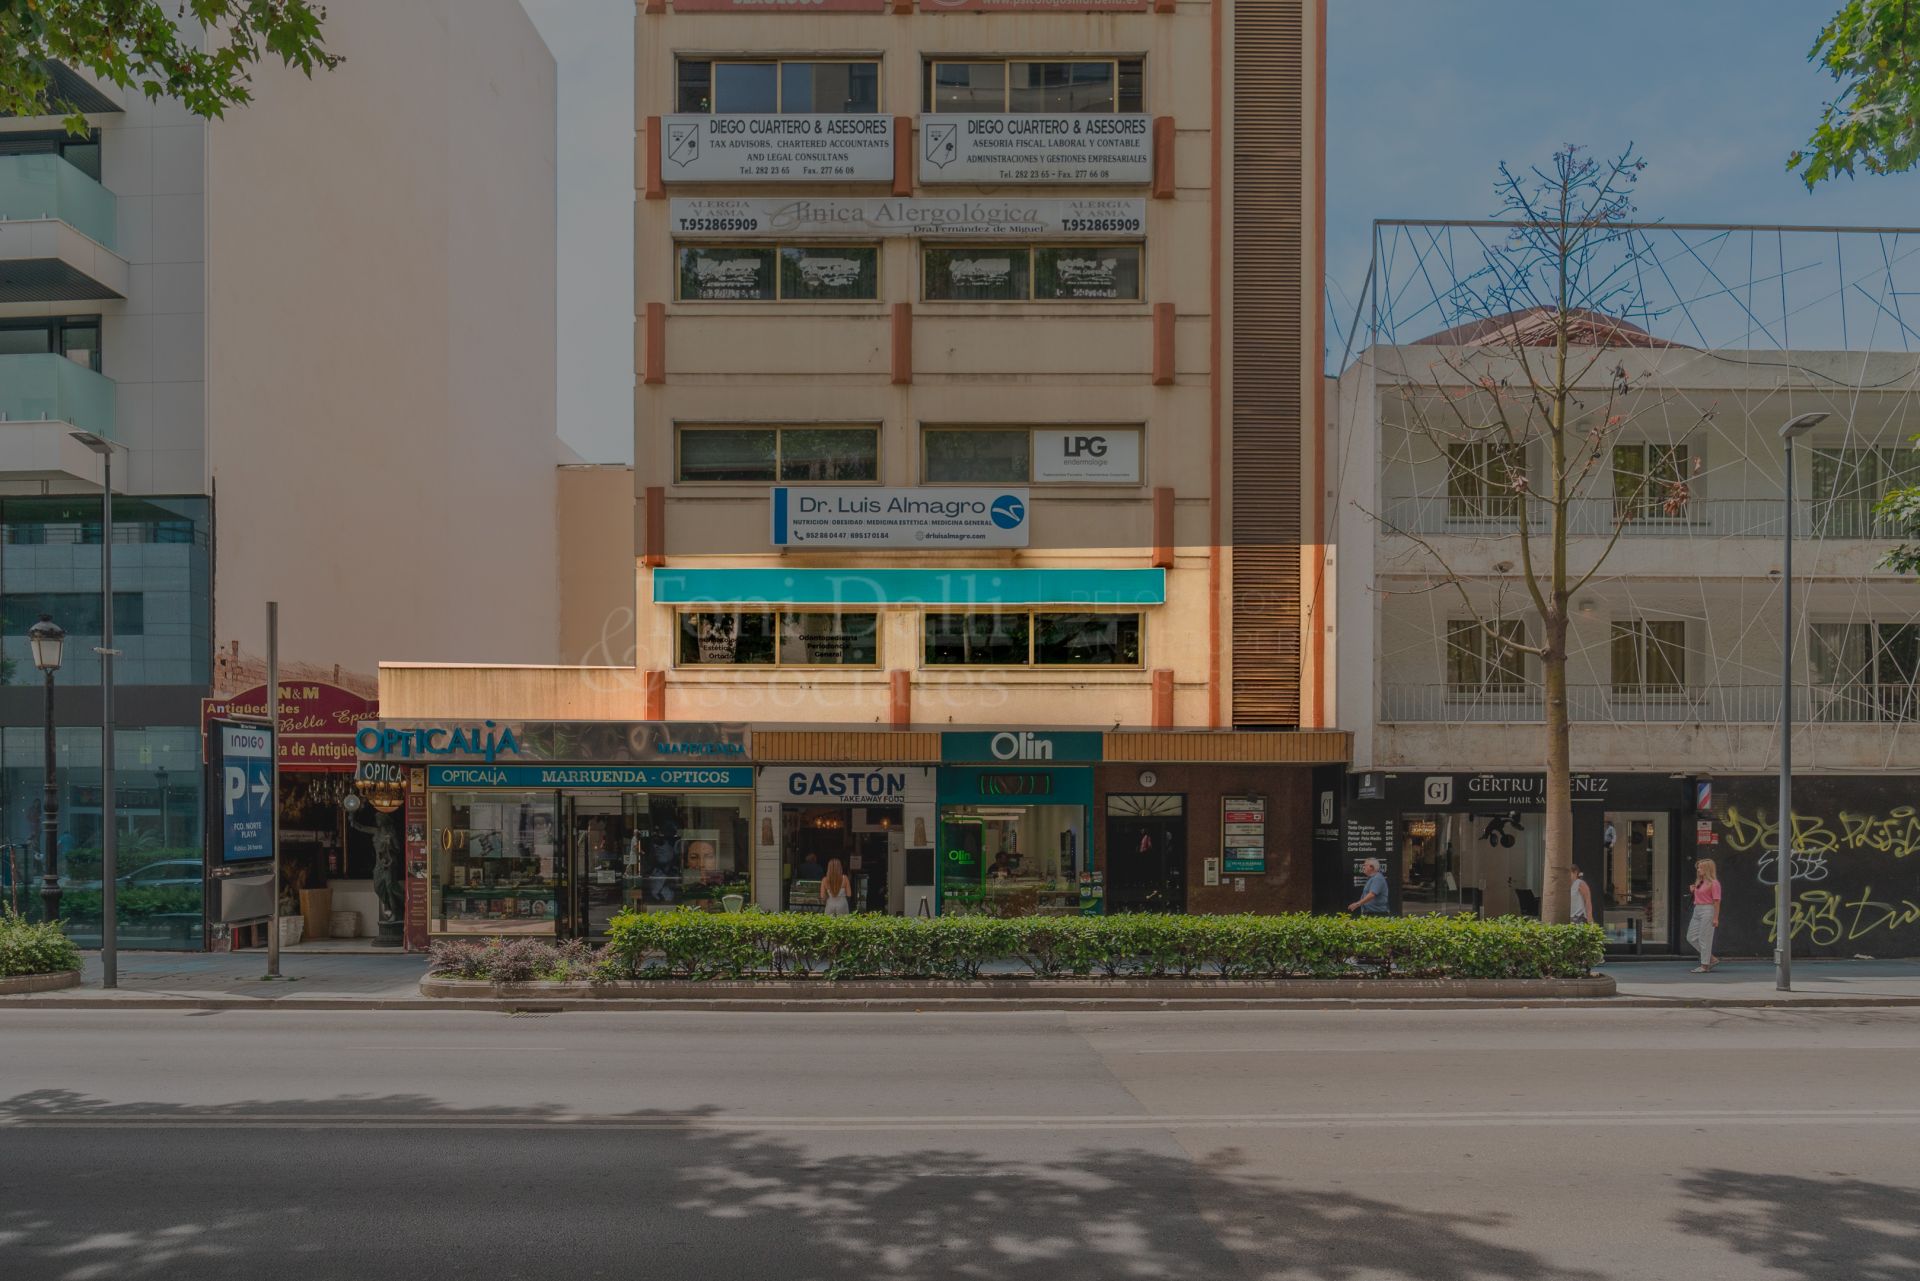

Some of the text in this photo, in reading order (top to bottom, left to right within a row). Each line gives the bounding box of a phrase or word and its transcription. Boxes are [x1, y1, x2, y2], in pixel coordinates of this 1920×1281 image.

[710, 119, 887, 134] DIEGO CUARTERO & ASESORES
[968, 119, 1146, 134] DIEGO CUARTERO & ASESORES
[710, 140, 889, 149] TAX ADVISORS, CHARTERED ACCOUNTANTS
[973, 139, 1013, 148] ASESORIA
[1048, 139, 1086, 148] LABORAL
[1089, 139, 1096, 147] Y
[1097, 139, 1140, 148] CONTABLE
[747, 153, 849, 161] AND LEGAL CONSULTANS
[966, 155, 1147, 163] ADMINISTRACIONES Y GESTIONES EMPRESARIALES
[740, 166, 854, 175] Tel. 282 23 65 Fax. 277 66 08
[1000, 170, 1013, 178] Tel.
[1015, 170, 1028, 178] 282
[1030, 170, 1040, 178] 23
[1041, 170, 1050, 178] 65
[1057, 170, 1073, 178] Fax.
[1075, 170, 1088, 178] 277
[1090, 170, 1099, 178] 66
[1100, 170, 1109, 178] 08
[1069, 201, 1131, 209] ALERGIA
[875, 202, 1038, 226] Alergológica
[1074, 210, 1126, 218] Y ASMA
[680, 218, 758, 231] T.952865909
[993, 225, 1007, 233] de
[1009, 225, 1044, 234] Miguel
[1062, 218, 1140, 231] T.952865909
[1063, 436, 1108, 457] LPG
[800, 496, 986, 517] Dr. Luis Almagro
[278, 687, 319, 700] N&M
[206, 703, 300, 715] Antigüeddes
[278, 714, 327, 732] Bella
[231, 734, 264, 751] INDIGO
[291, 742, 305, 756] de
[655, 742, 745, 755] MARRUENDA
[991, 732, 1053, 760] Olin
[542, 770, 648, 783] MARRUENDA
[660, 770, 730, 784] OPTICOS
[788, 767, 905, 796] GASTÓN
[224, 766, 246, 815] P
[1468, 778, 1609, 794] GERTRU JENEZ
[883, 795, 905, 803] FOOD
[1427, 782, 1449, 804] GJ
[1509, 796, 1531, 805] HAIR
[948, 850, 972, 861] Olin
